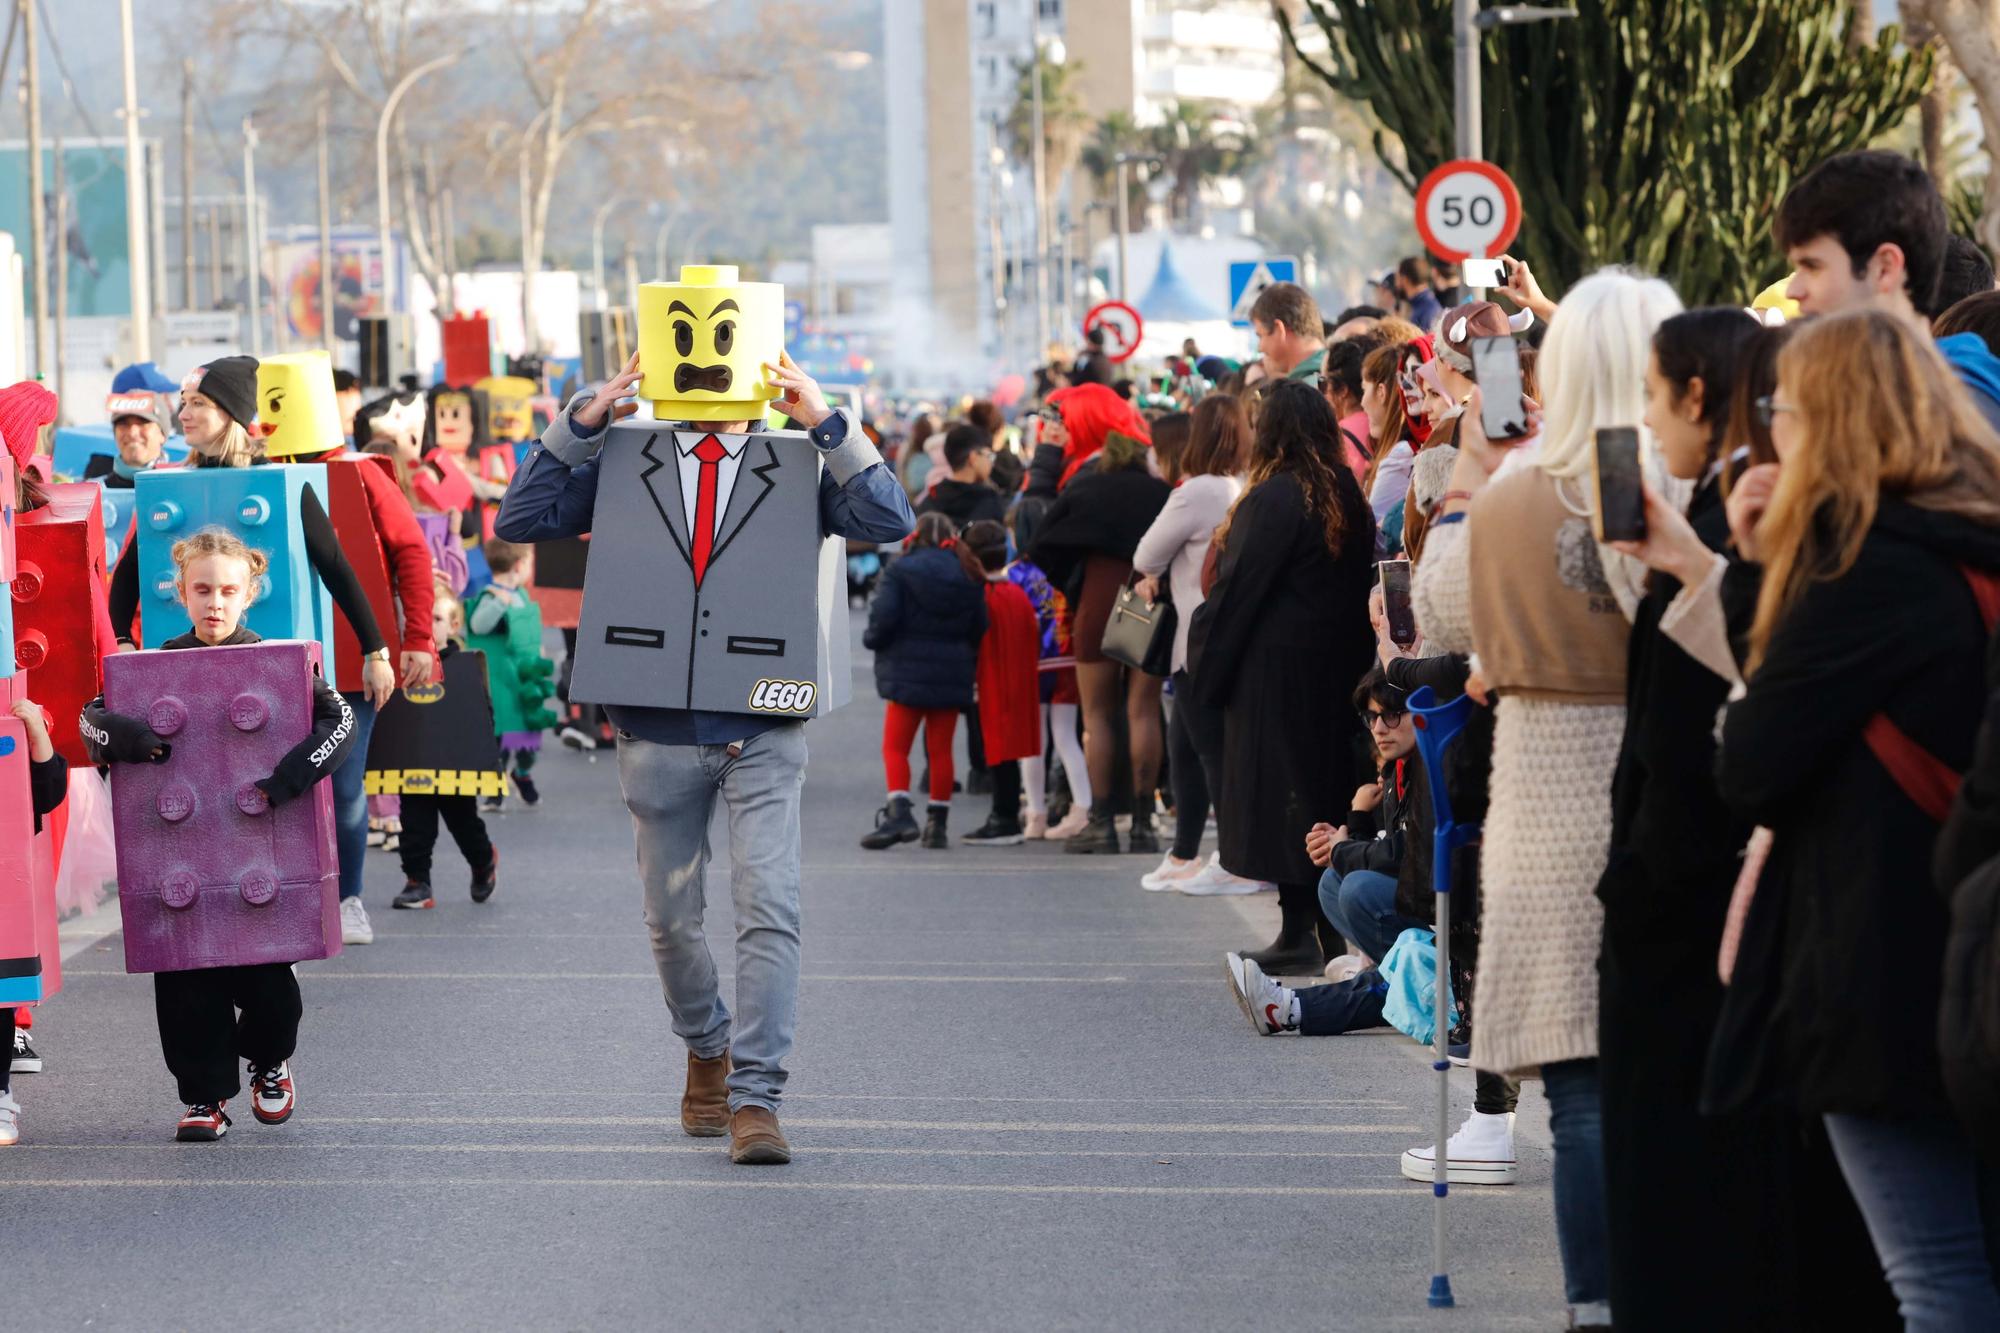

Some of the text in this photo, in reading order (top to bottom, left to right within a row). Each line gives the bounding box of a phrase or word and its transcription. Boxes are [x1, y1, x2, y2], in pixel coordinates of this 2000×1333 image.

[1443, 196, 1494, 227] 50
[153, 511, 168, 521] LEGO
[242, 507, 258, 516] LEGO
[750, 681, 815, 711] LEGO
[243, 877, 274, 899] LEGO
